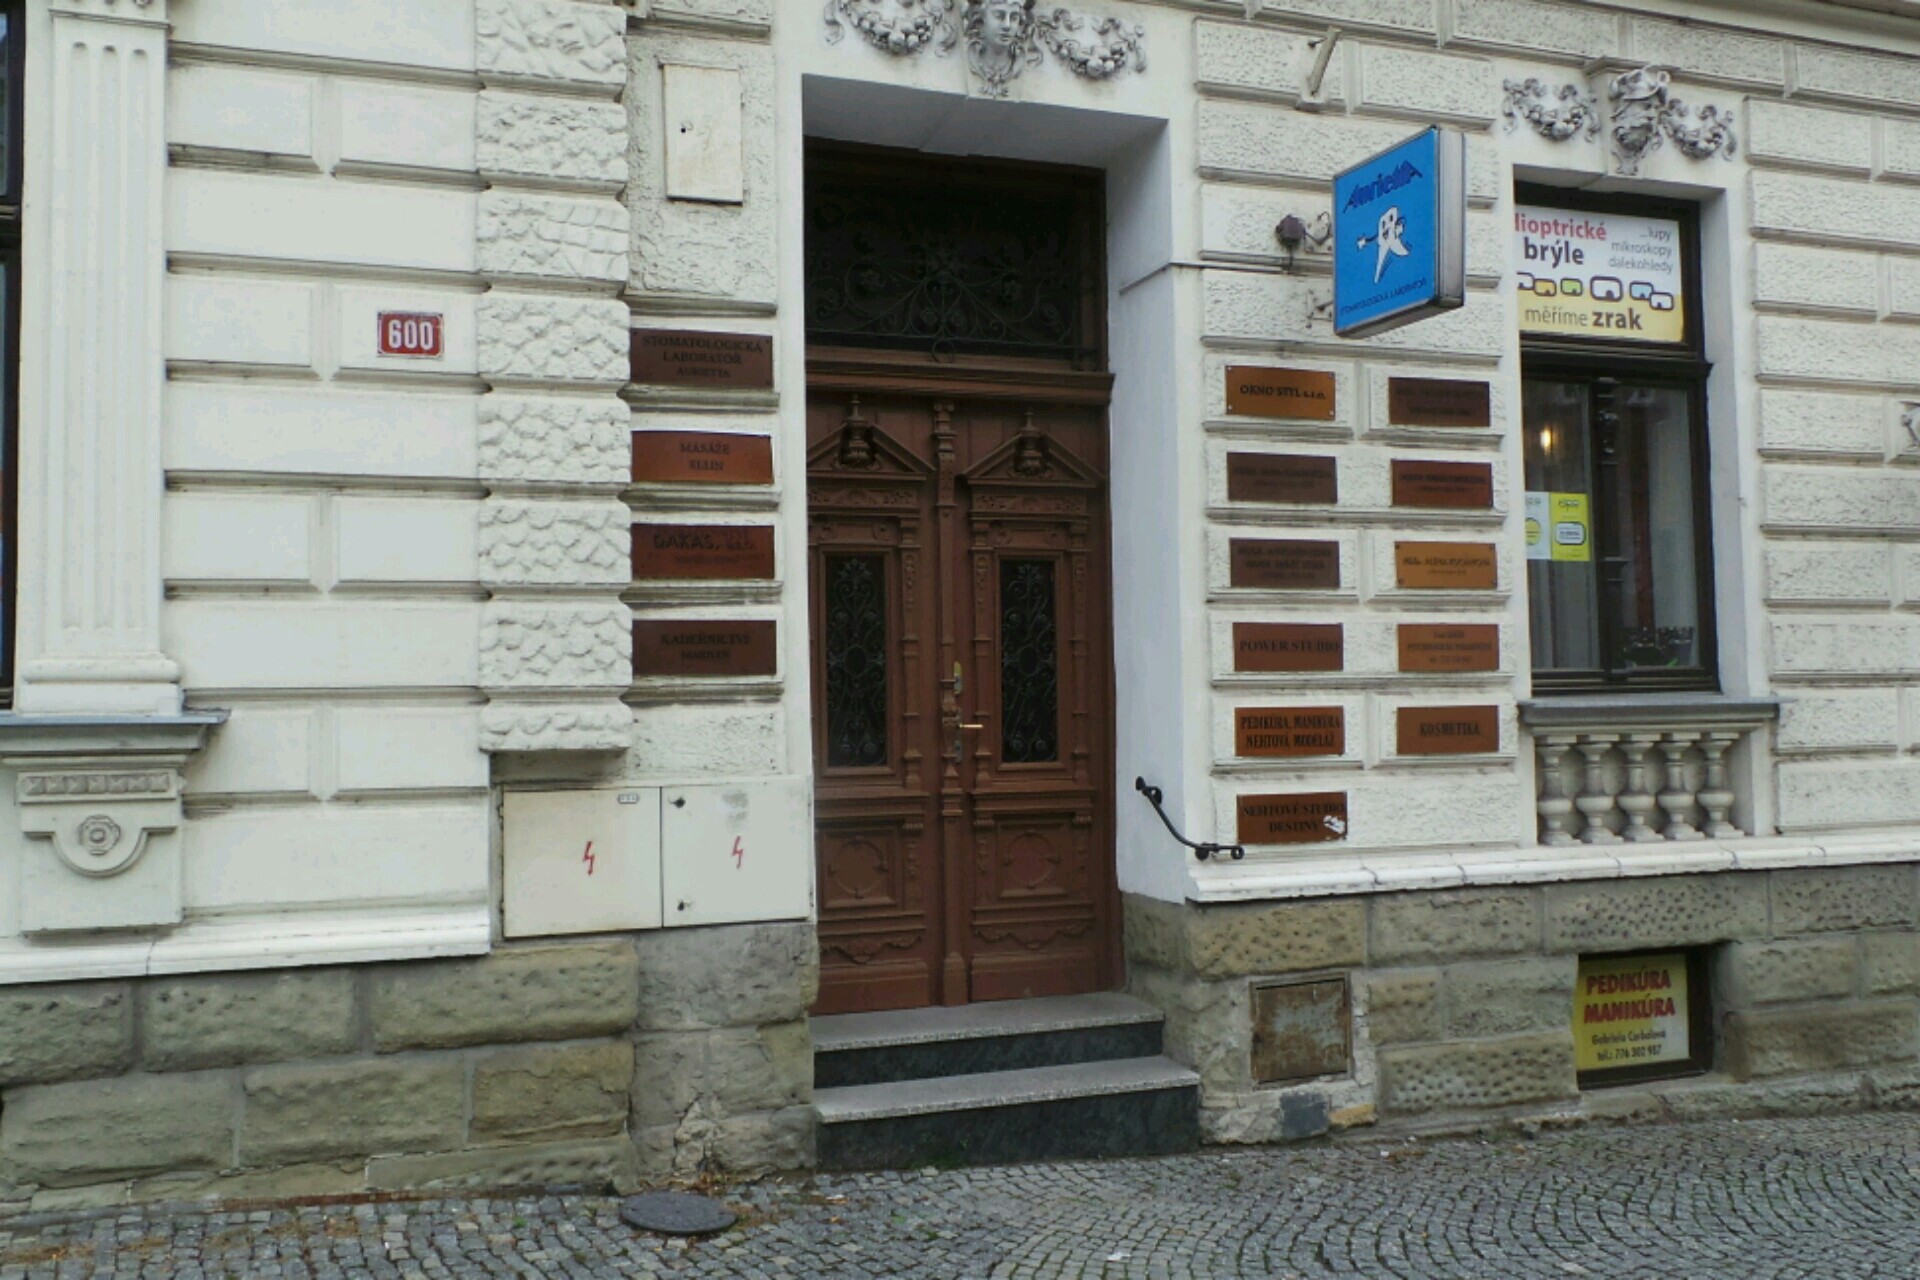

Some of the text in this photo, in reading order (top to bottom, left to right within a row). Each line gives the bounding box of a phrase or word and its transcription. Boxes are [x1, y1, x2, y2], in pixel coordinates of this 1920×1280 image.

[1524, 237, 1585, 269] brýle
[1611, 241, 1672, 259] mikroskopy
[1608, 256, 1674, 275] dalekohledy
[1525, 305, 1643, 331] měříme zrak
[388, 319, 433, 350] 600
[642, 335, 764, 353] STOMATOLOGICKÁ
[663, 350, 742, 365] LABORATOŘ
[1240, 384, 1274, 396] OKNO
[1240, 639, 1341, 653] POWER STUDIO
[1419, 721, 1481, 737] KOSMETIKA
[1586, 964, 1671, 995] PEDIKÚRA
[1583, 994, 1676, 1024] MANIKÚRA
